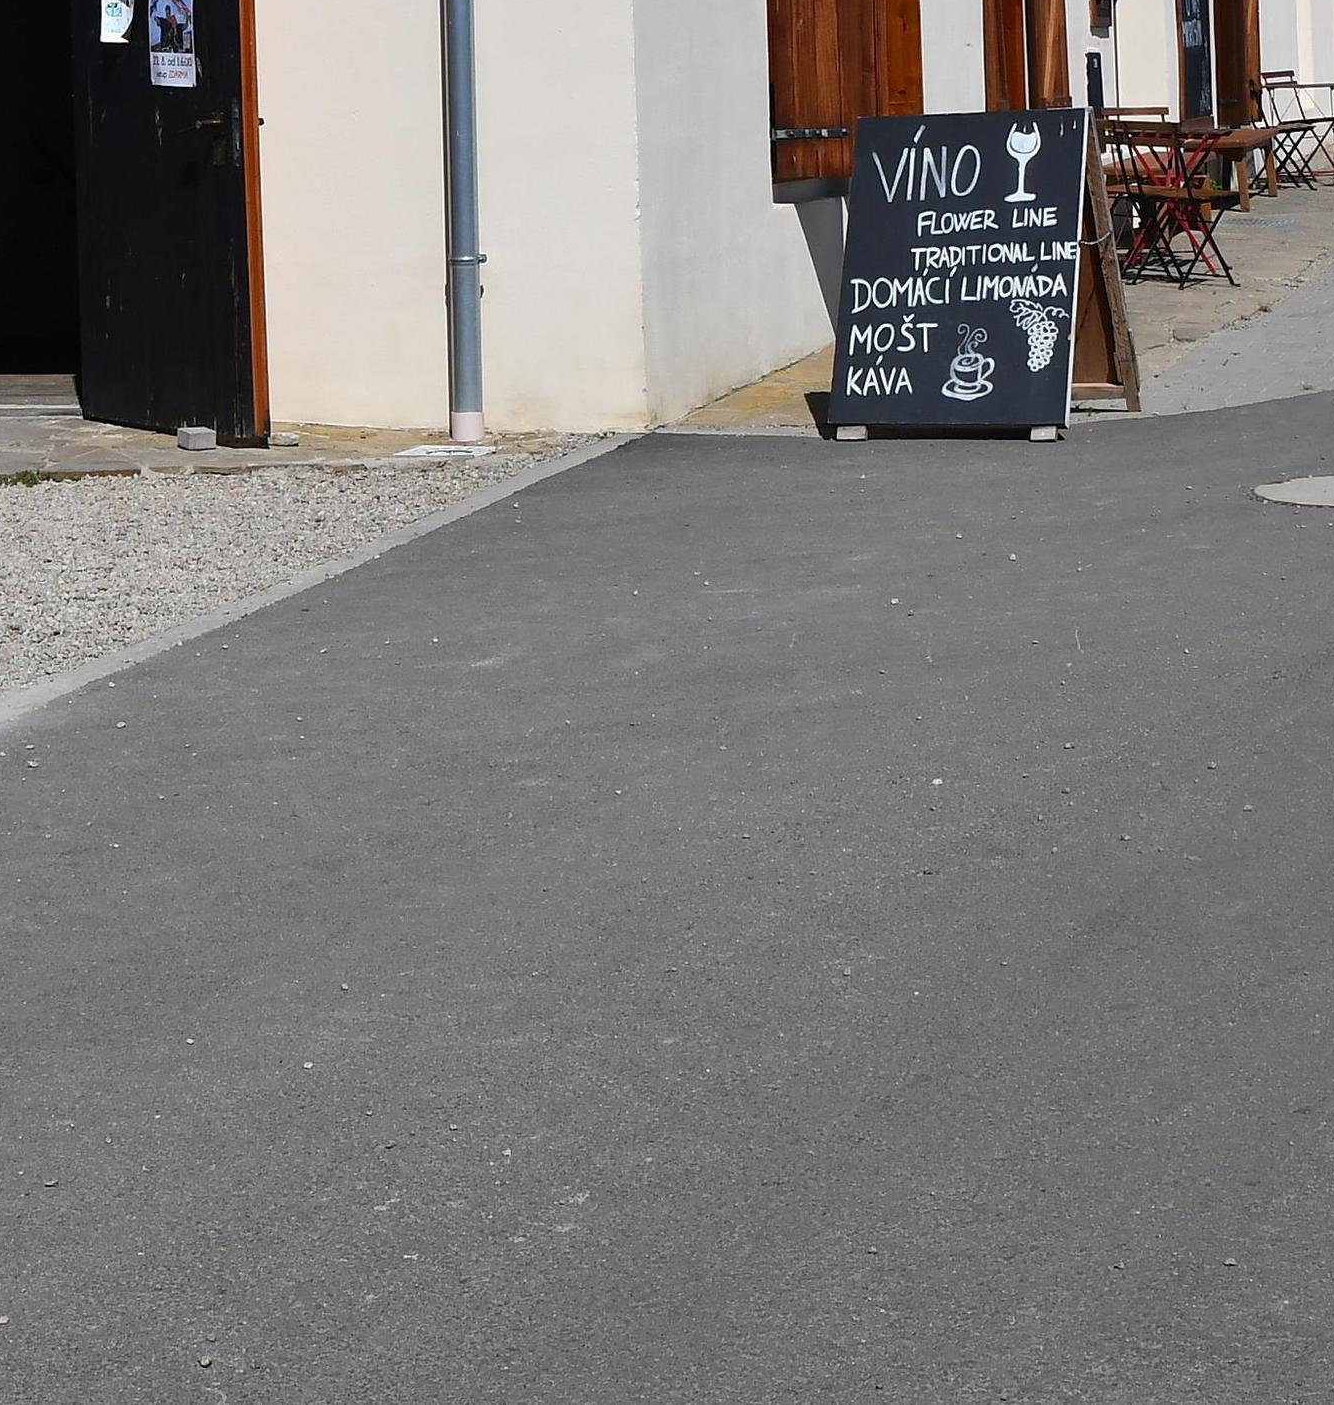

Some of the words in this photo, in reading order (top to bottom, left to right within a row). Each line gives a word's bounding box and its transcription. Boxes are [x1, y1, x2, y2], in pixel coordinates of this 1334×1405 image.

[871, 124, 981, 203] VÍNO
[916, 209, 999, 237] FLOWER
[1011, 207, 1058, 229] LINE
[911, 243, 1035, 271] TRADITIONAL
[1041, 242, 1077, 262] LINE
[850, 266, 957, 314] DOMÁCÍ
[960, 263, 1067, 302] LIMONÁDA
[848, 315, 938, 356] MOŠT
[846, 355, 913, 397] KÁVA
